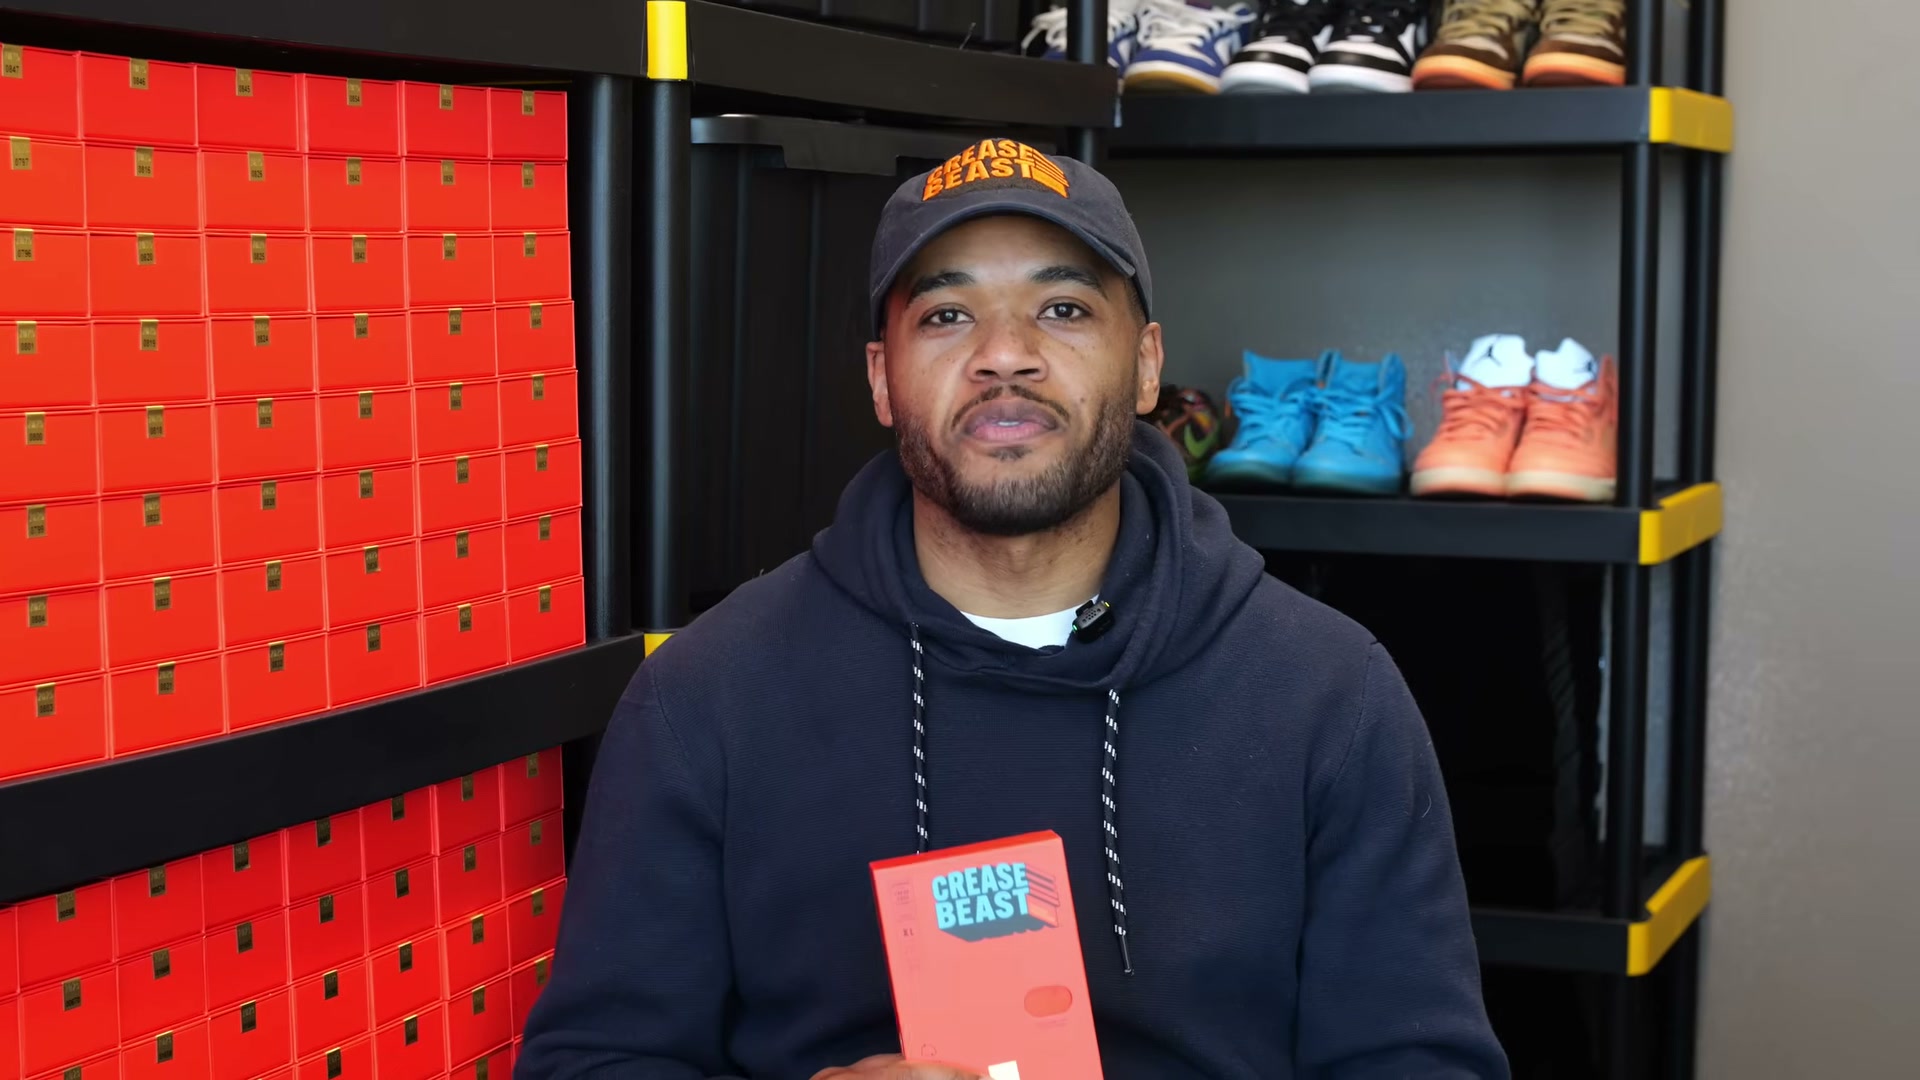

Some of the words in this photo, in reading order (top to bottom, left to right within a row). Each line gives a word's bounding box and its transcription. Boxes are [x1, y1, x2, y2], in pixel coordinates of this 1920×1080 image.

[922, 158, 1036, 201] BEAST
[926, 138, 1035, 184] CREASE
[932, 862, 1030, 903] CREASE
[935, 887, 1030, 929] BEAST
